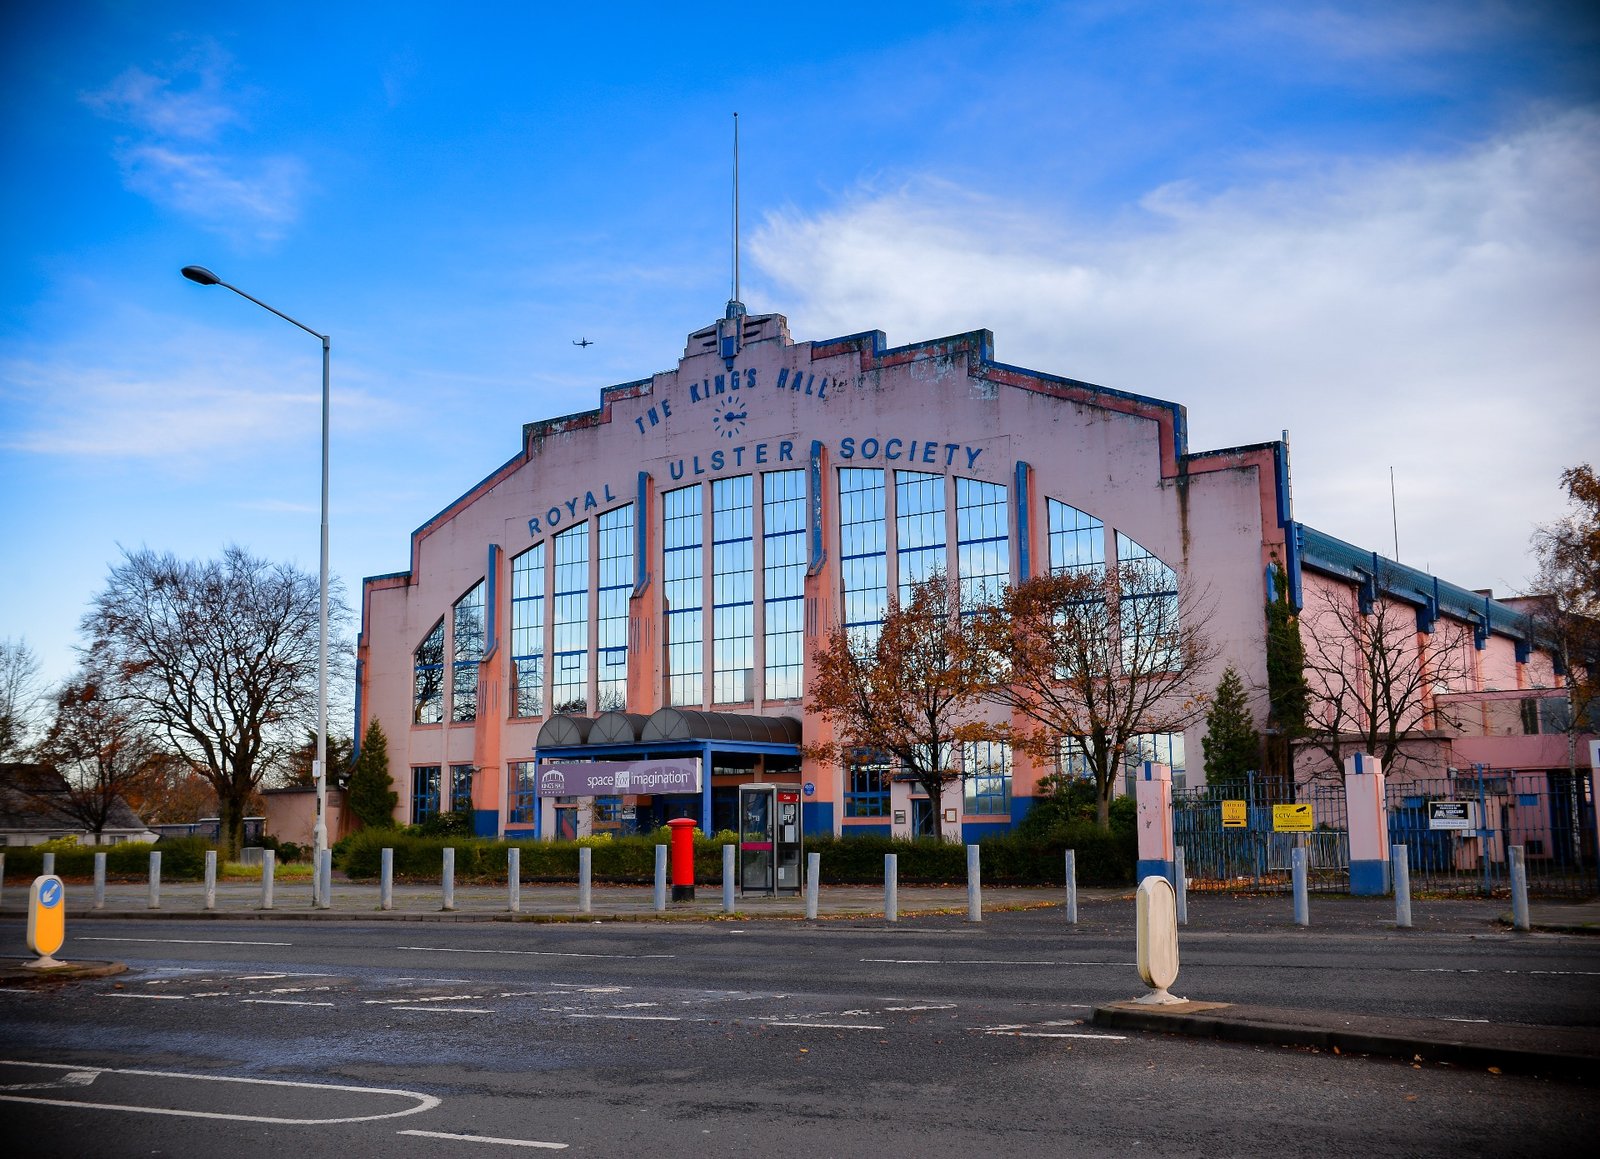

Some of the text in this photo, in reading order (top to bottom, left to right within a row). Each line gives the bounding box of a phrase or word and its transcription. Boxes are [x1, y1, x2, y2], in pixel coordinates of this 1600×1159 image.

[635, 367, 828, 434] THE KING'S HALL
[527, 437, 983, 538] ROYAL ULSTER SOCIETY
[587, 771, 688, 788] space for imagination
